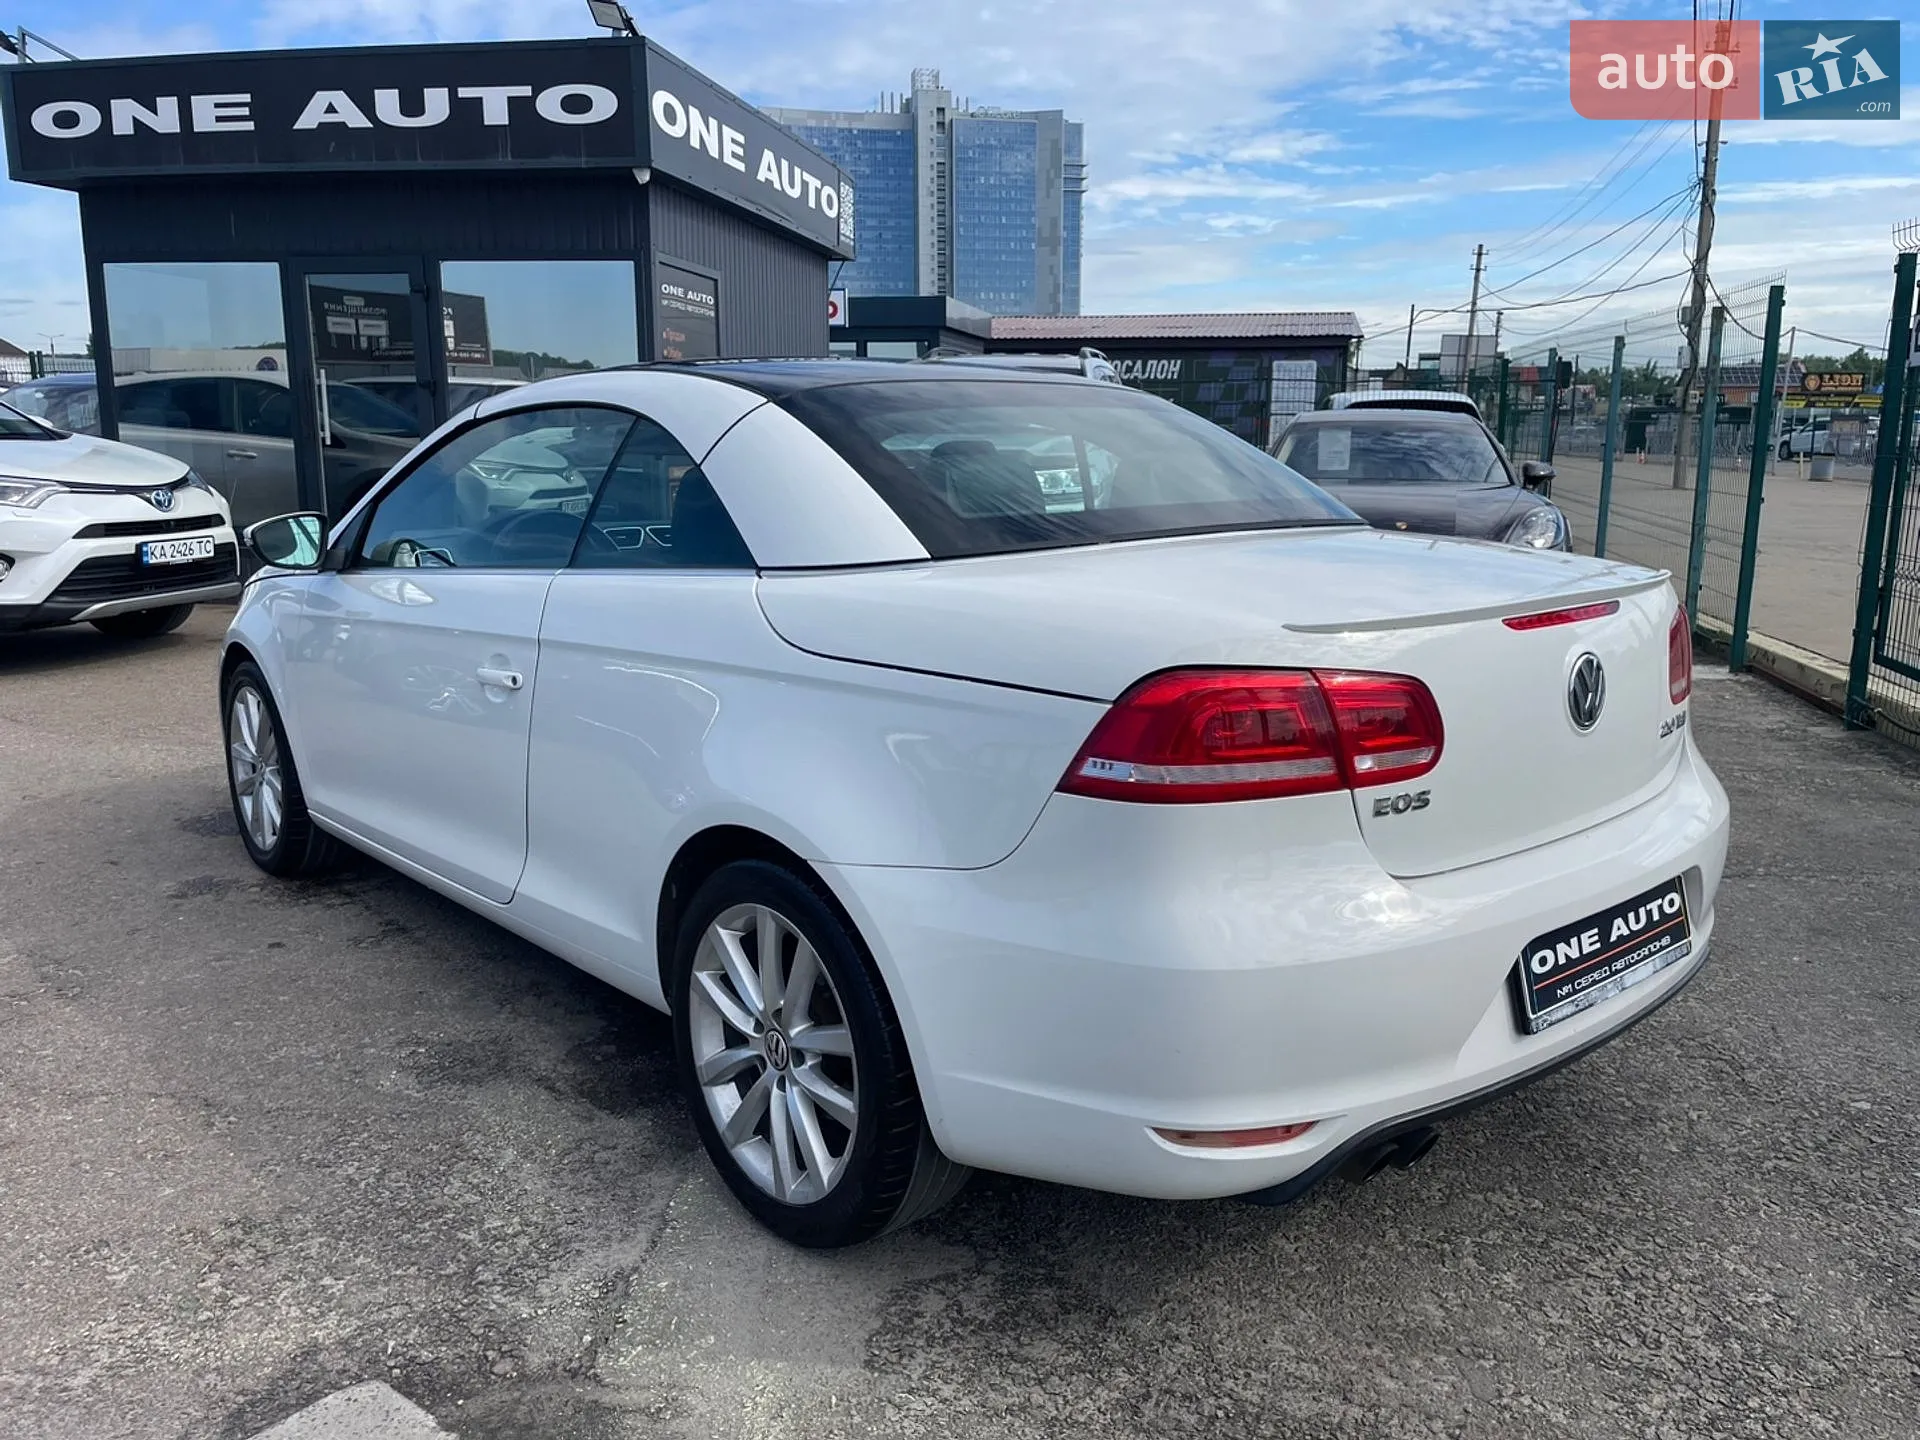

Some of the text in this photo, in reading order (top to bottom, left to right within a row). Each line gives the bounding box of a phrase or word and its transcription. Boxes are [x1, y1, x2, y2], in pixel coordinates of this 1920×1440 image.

[30, 83, 619, 139] ONE AUTO
[652, 90, 839, 219] ONE AUTO
[661, 283, 715, 305] ONE AUTO
[1109, 359, 1182, 380] ОСАЛОН
[149, 540, 212, 560] KA 2426 TC
[1372, 789, 1431, 818] EOS
[1530, 891, 1681, 975] ONE AUTO
